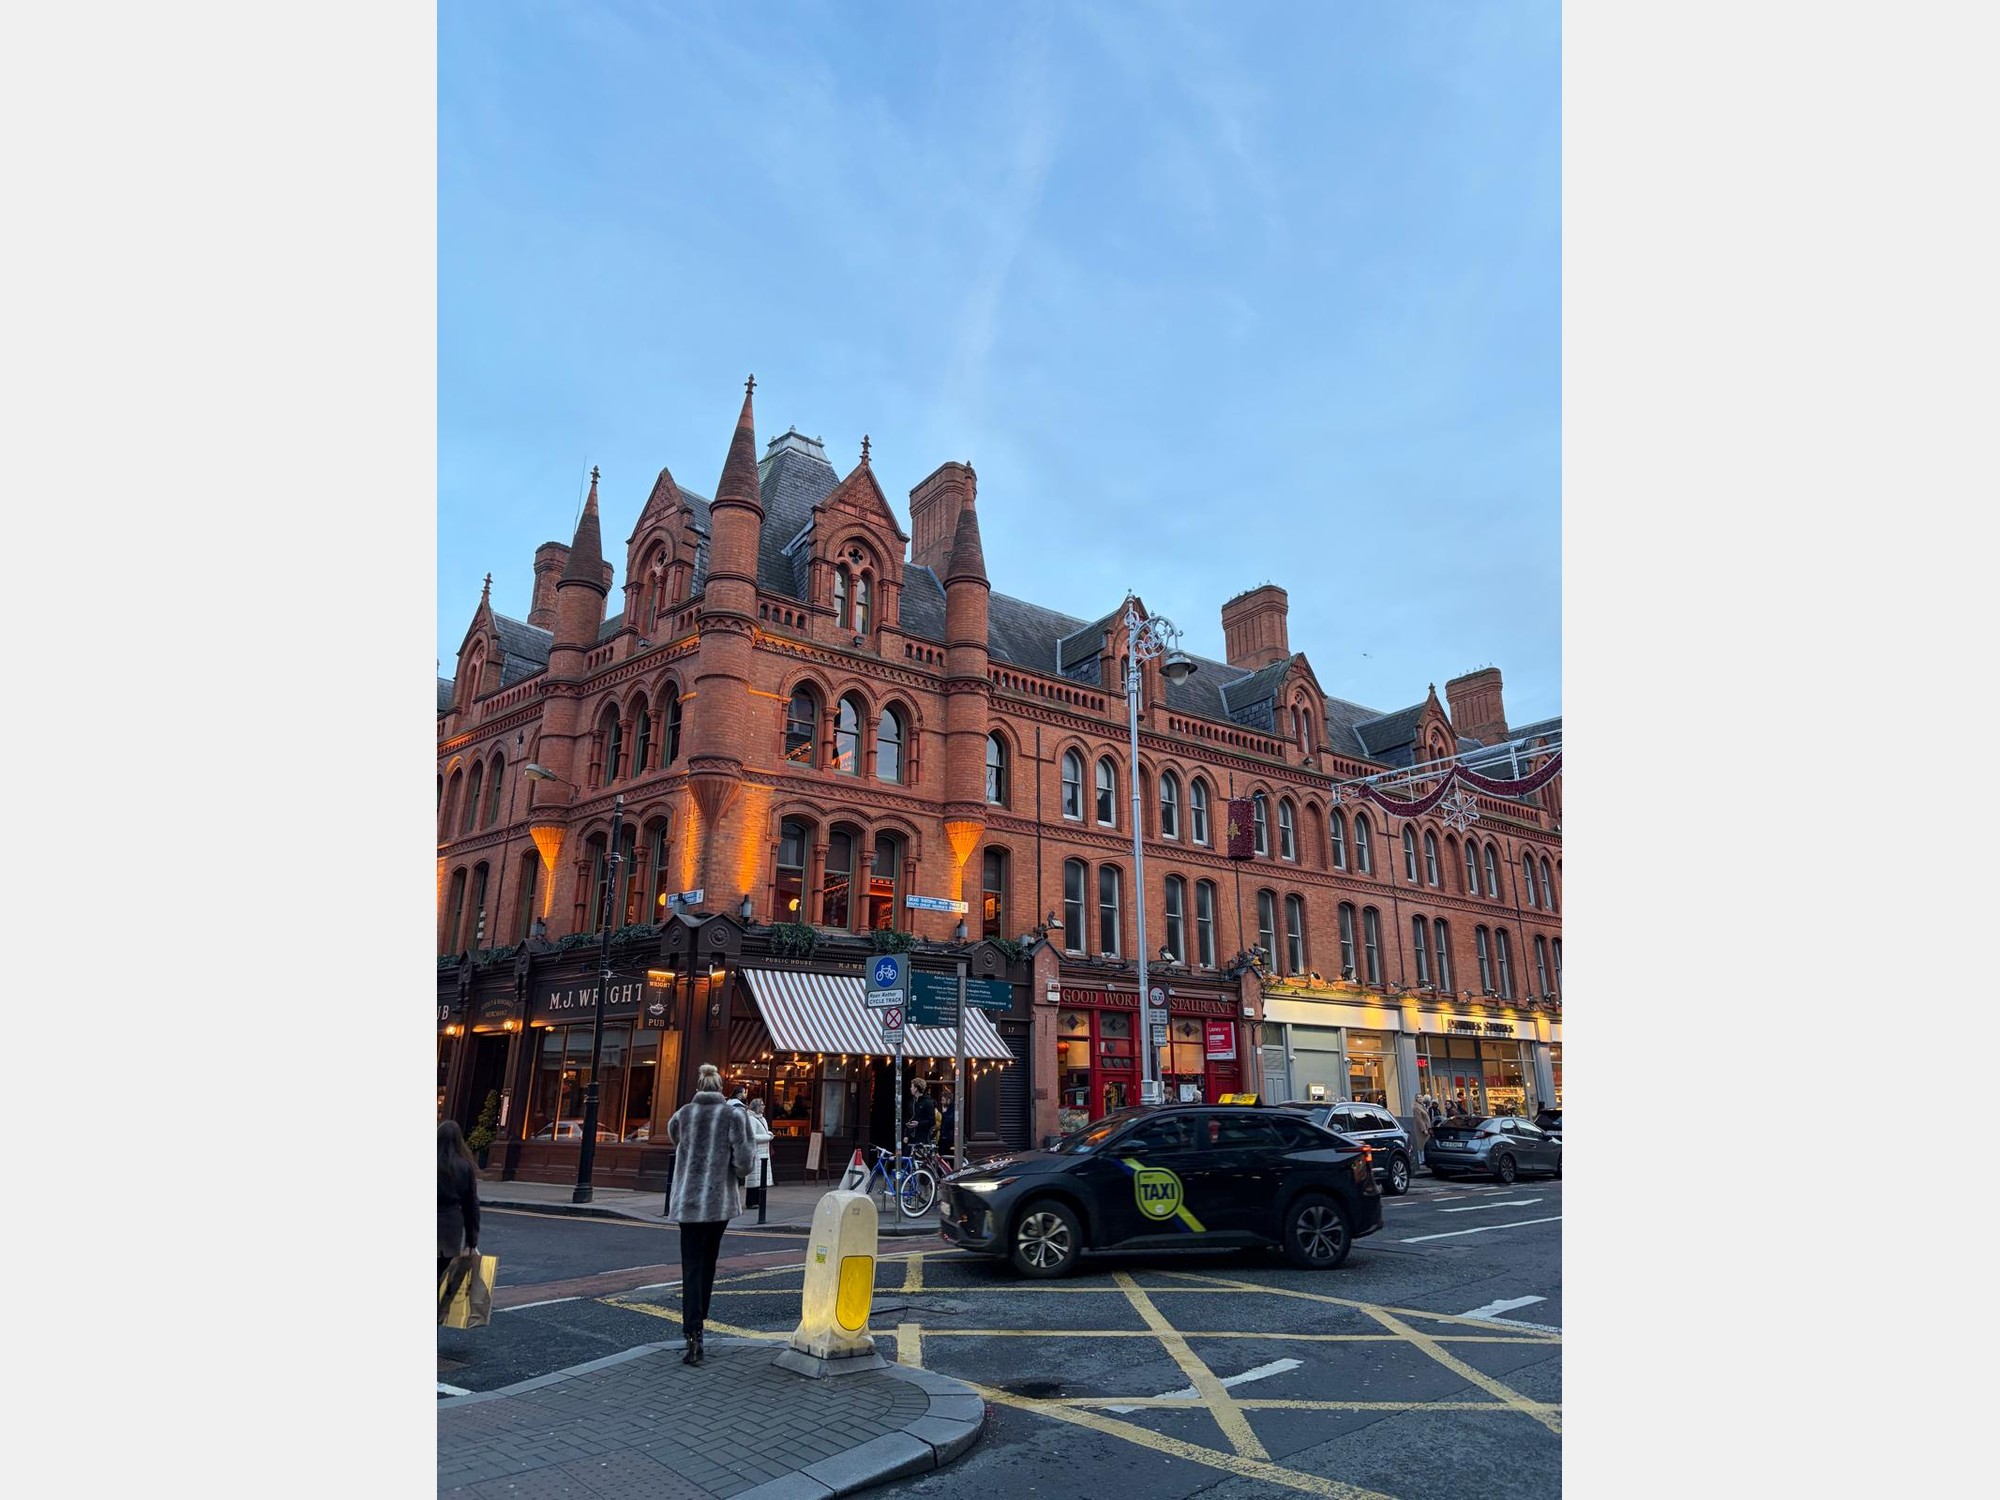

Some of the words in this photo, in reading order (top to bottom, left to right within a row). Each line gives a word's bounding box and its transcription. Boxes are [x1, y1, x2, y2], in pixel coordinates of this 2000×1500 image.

[549, 990, 574, 1010] M.J.
[1062, 988, 1098, 1003] GOOD
[1104, 992, 1141, 1007] WORL
[1170, 997, 1232, 1014] STAURANT
[648, 1018, 665, 1027] PUB
[1141, 1183, 1175, 1201] TAXI
